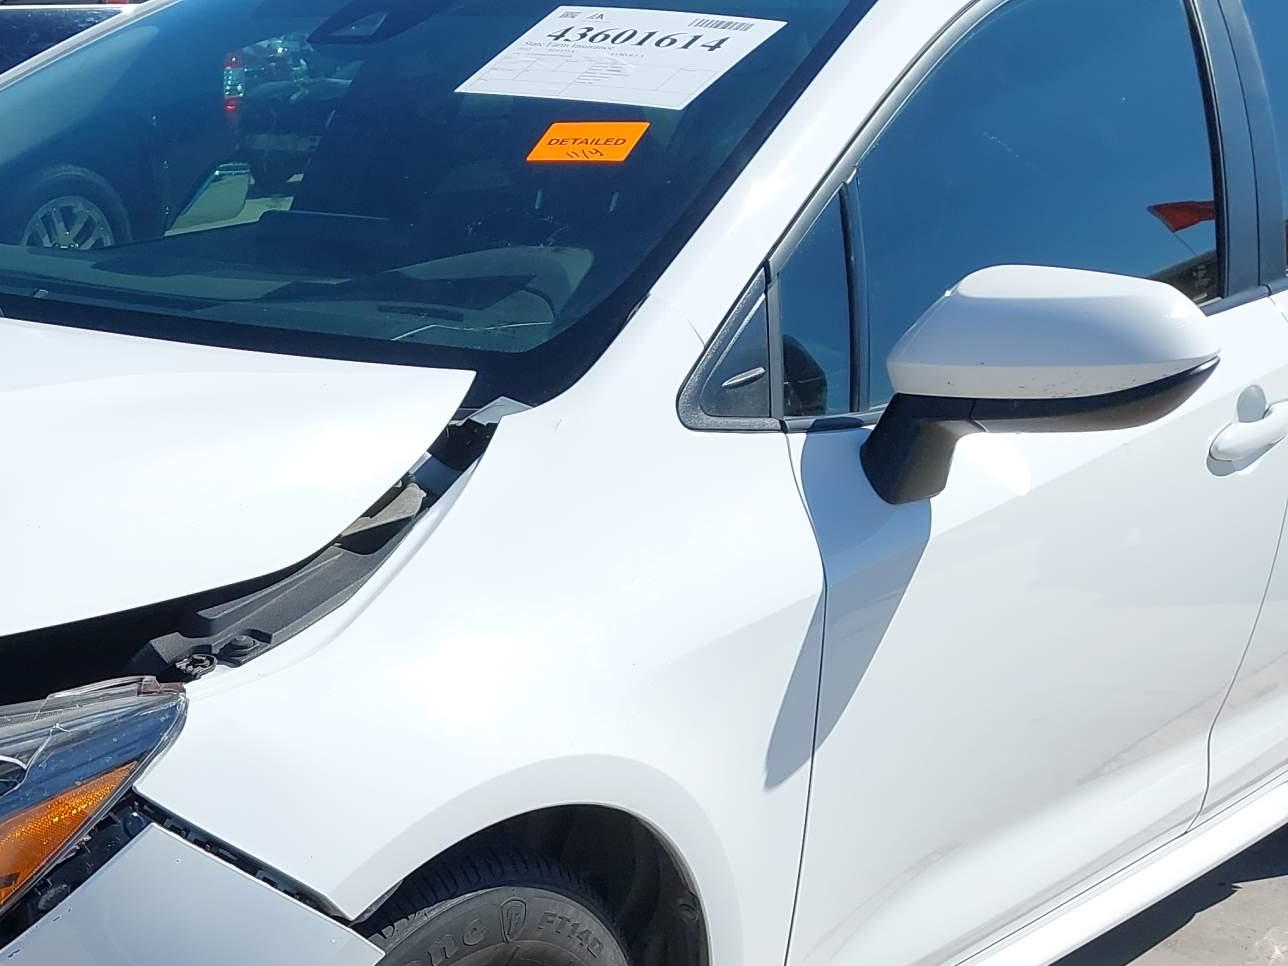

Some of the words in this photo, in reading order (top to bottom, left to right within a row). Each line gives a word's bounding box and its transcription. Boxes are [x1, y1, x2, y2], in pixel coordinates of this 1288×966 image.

[545, 25, 731, 52] 43601614
[546, 137, 627, 146] DETAILED
[536, 910, 605, 959] FT140
